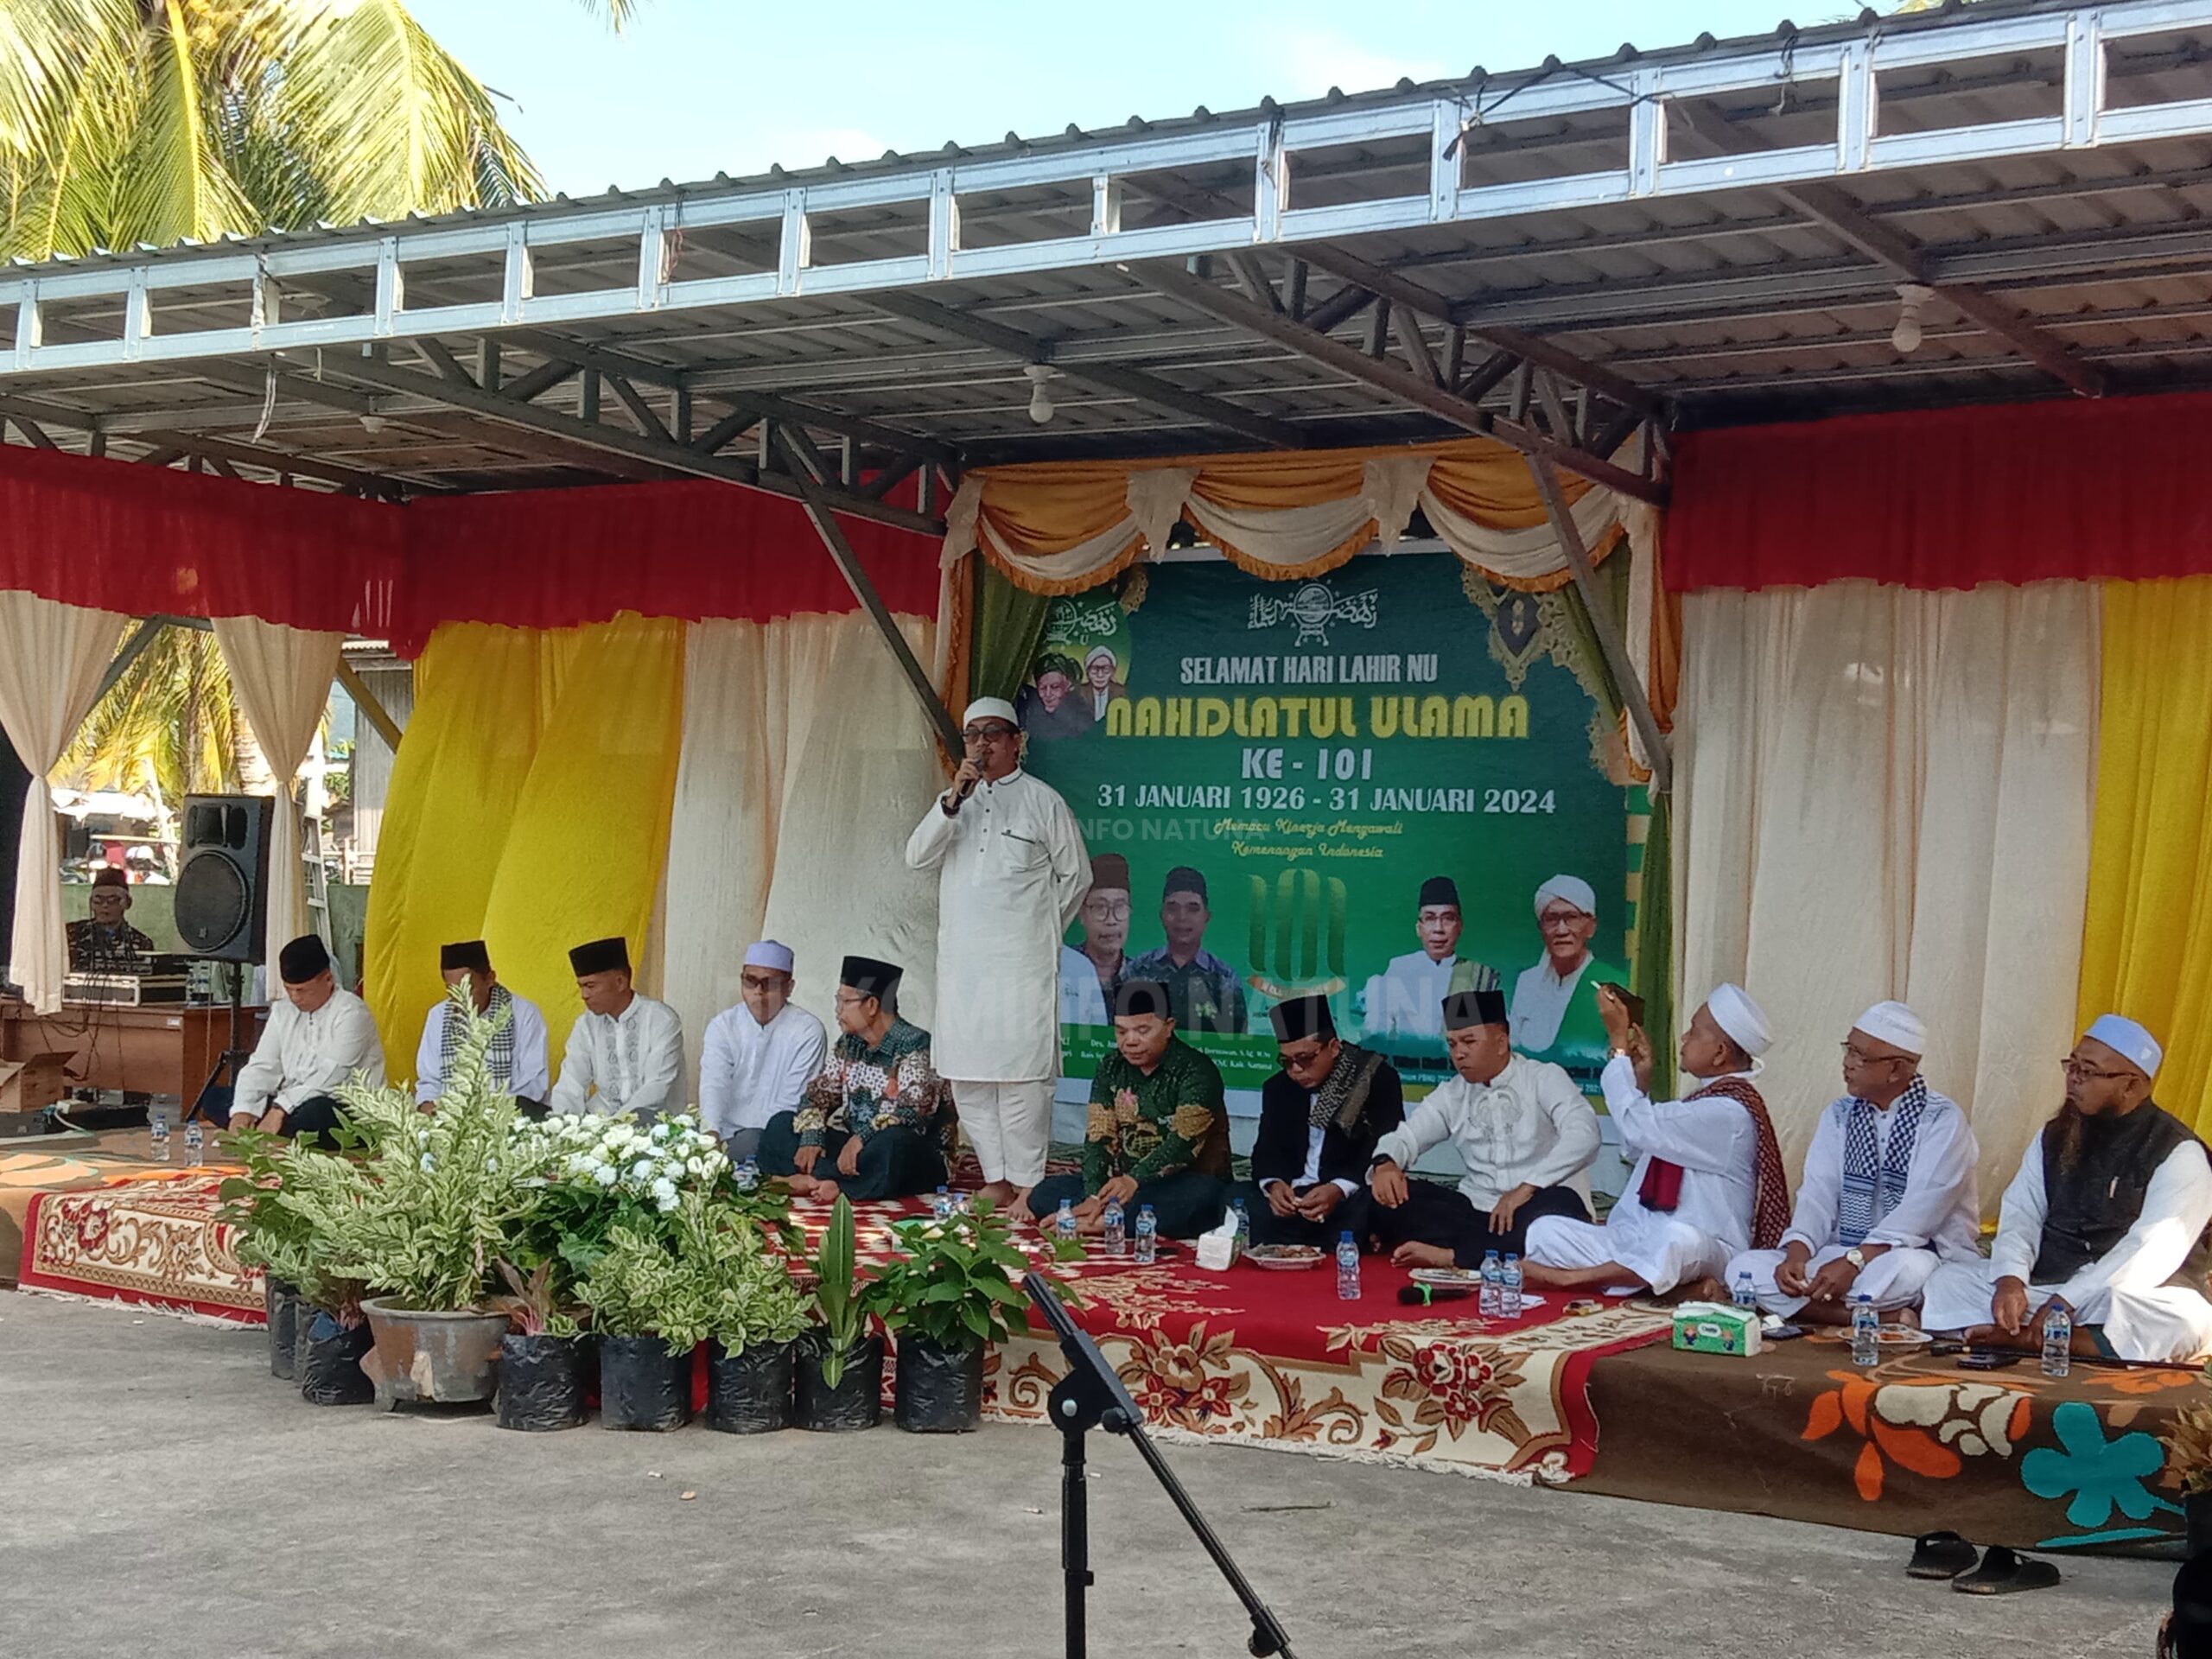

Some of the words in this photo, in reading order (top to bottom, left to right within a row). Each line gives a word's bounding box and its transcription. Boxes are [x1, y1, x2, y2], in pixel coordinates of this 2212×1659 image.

[1180, 654, 1276, 684] SELAMAT
[1282, 654, 1333, 683] HARI
[1338, 654, 1401, 683] LAHIR
[1406, 653, 1438, 683] NU
[1105, 694, 1357, 739] NAHDLATUL
[1370, 694, 1529, 740] ULAMA
[1242, 748, 1282, 779] KE
[1317, 748, 1372, 780] 101
[1097, 784, 1124, 807] 31
[1135, 784, 1230, 809] JANUARI
[1241, 785, 1306, 810] 1926
[1329, 786, 1359, 810] 31
[1370, 787, 1474, 812] JANUARI
[1483, 788, 1556, 814] 2024
